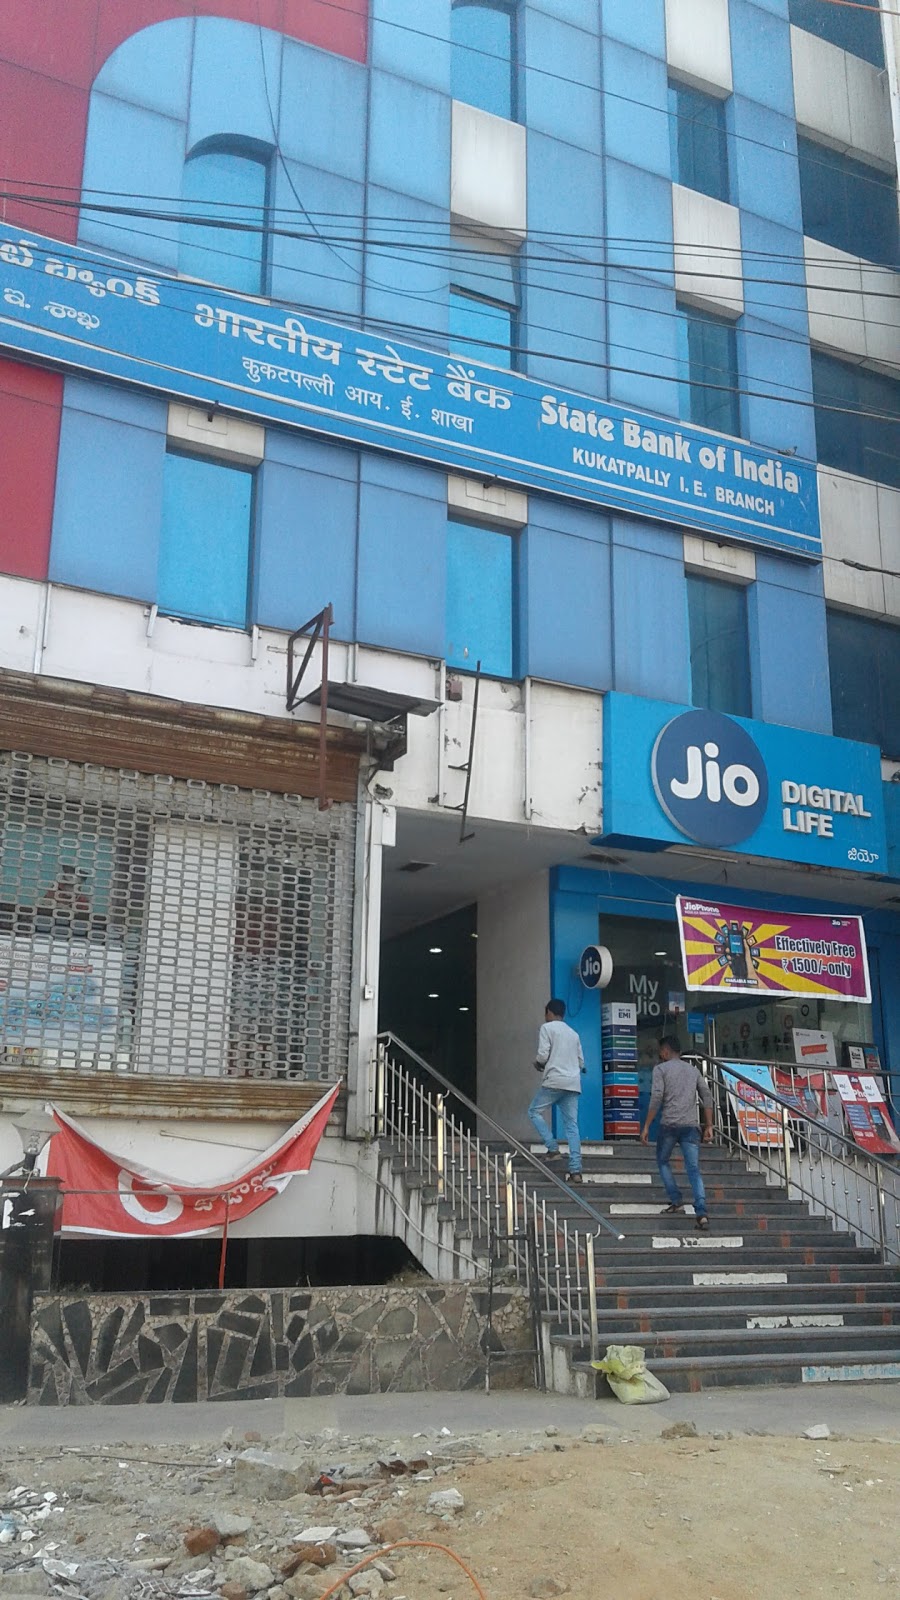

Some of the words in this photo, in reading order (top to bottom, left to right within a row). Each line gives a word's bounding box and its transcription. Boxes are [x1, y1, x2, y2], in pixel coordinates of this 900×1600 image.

[194, 303, 343, 366] भारतीय
[355, 344, 434, 391] स्टेट
[445, 363, 514, 410] बैंक
[241, 356, 336, 397] कुकटपल्ली
[431, 408, 475, 434] शाखा
[541, 394, 615, 442] State
[623, 417, 692, 463] Bank
[698, 446, 726, 473] of
[733, 450, 799, 494] India
[572, 446, 671, 488] KUKATPALLY
[679, 476, 689, 493] I.
[693, 480, 707, 498] E.
[715, 486, 775, 516] BRANCH
[670, 742, 759, 807] Jio
[781, 780, 871, 817] DIGITAL
[782, 807, 834, 838] LIFE
[847, 847, 879, 863] జియో
[774, 935, 831, 957] Effectively
[831, 941, 856, 958] Free
[582, 956, 601, 977] Jio
[828, 961, 852, 978] only
[629, 973, 659, 1000] My
[636, 995, 661, 1017] Jio
